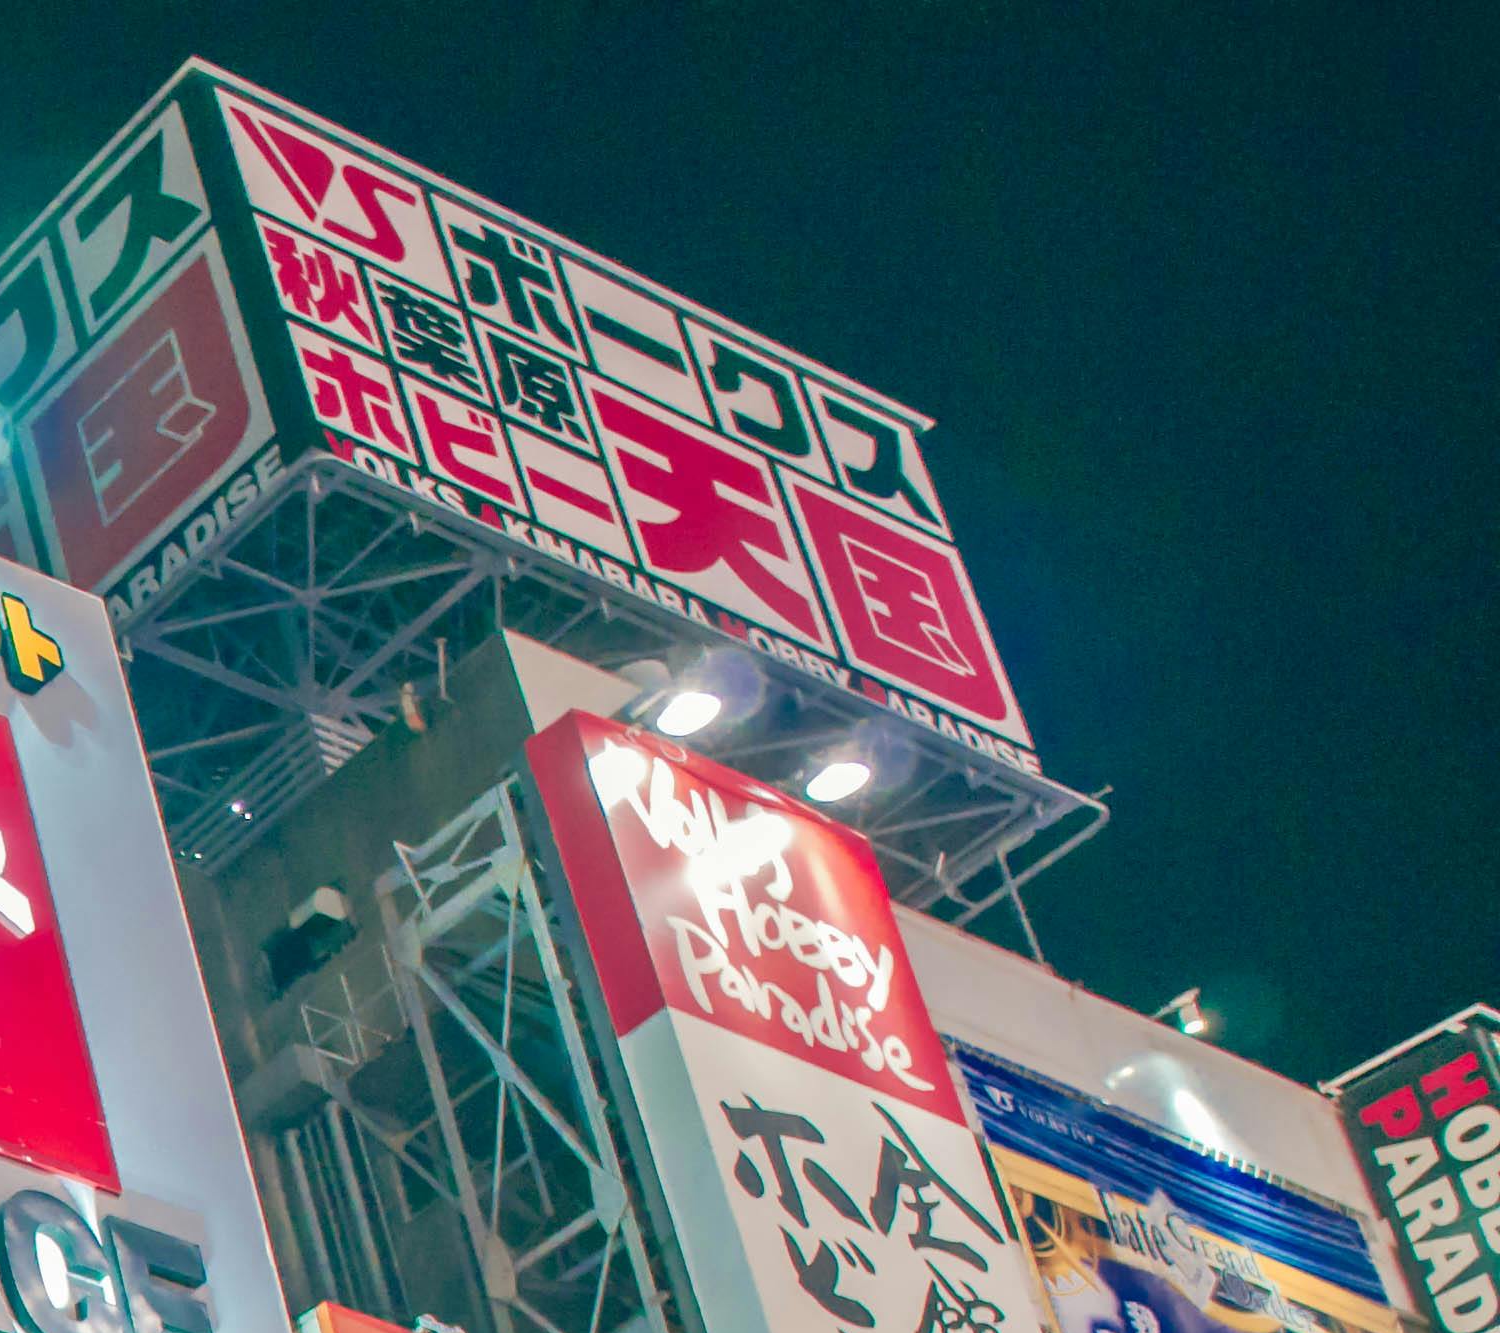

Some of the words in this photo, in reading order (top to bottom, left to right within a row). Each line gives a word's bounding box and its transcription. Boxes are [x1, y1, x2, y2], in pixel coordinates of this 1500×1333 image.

[266, 224, 578, 446] 秋葉原
[324, 430, 474, 520] VOLKS
[480, 503, 710, 630] AKIHABARA
[714, 610, 850, 691] HOBBY
[862, 676, 1045, 779] PARADISE
[664, 914, 936, 1092] Paradise
